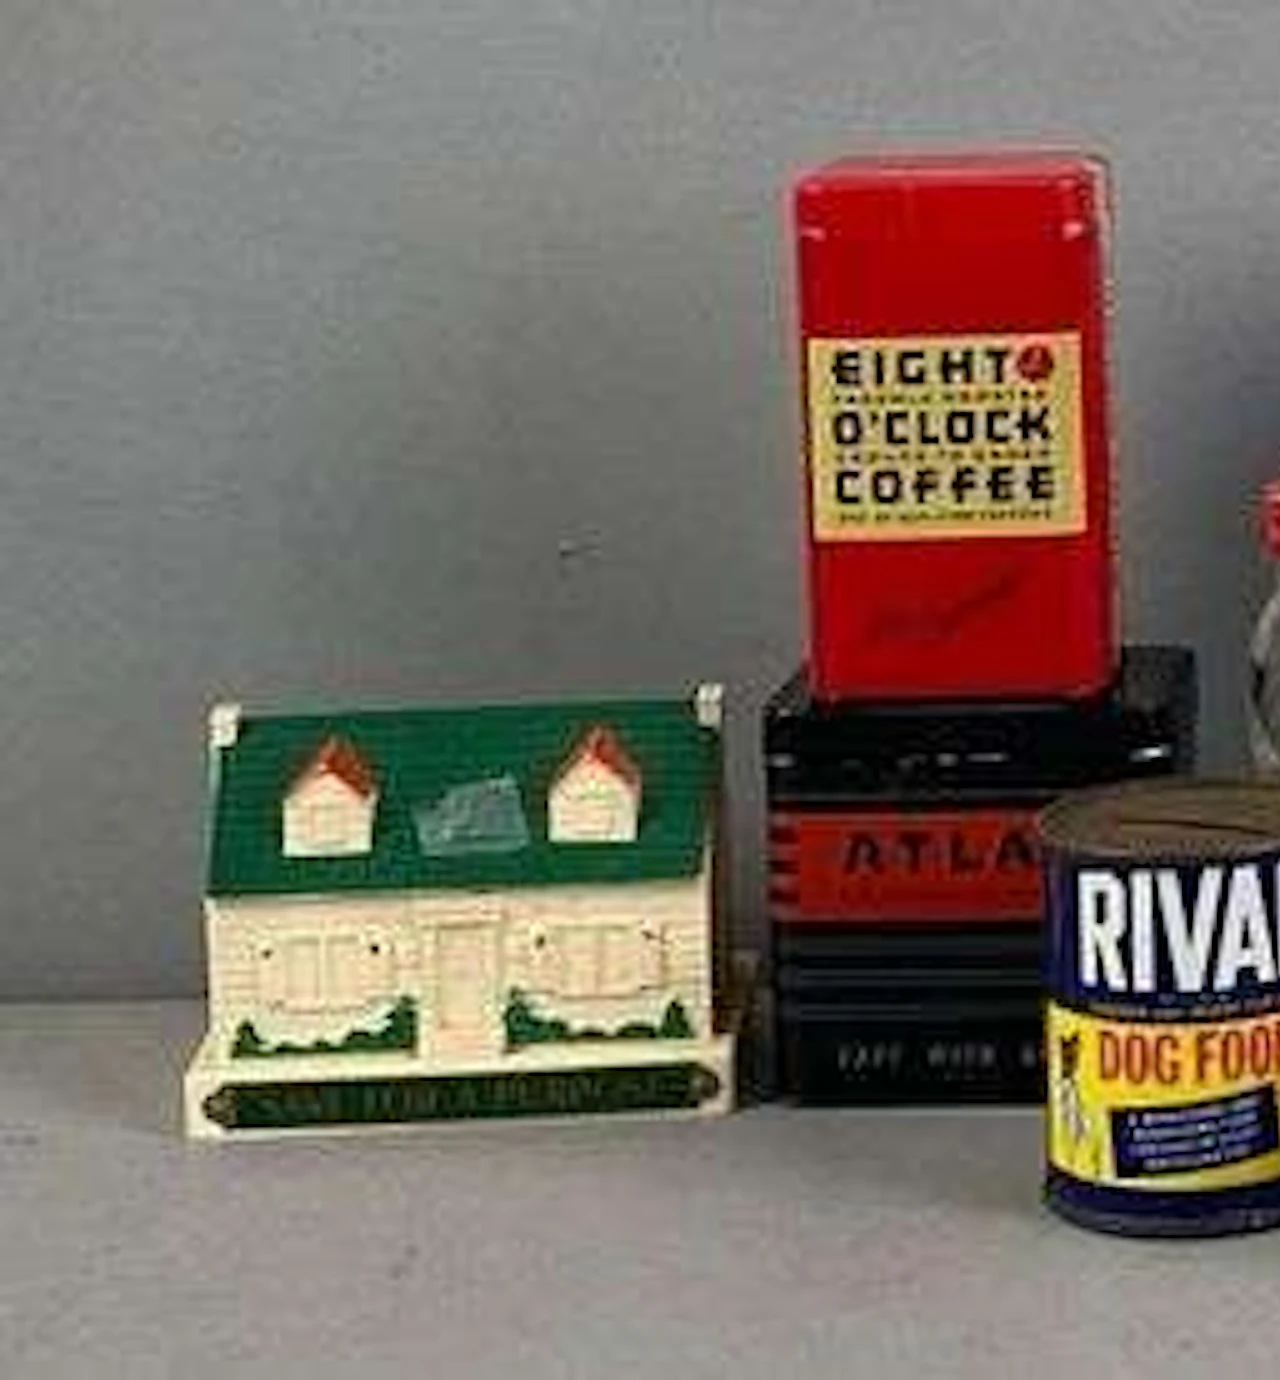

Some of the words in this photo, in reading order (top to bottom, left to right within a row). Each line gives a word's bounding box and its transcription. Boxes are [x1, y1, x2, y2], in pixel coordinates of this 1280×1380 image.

[831, 347, 1012, 385] EIGHT
[832, 407, 1049, 445] O'CLOCK
[835, 466, 1054, 503] COFFEE
[844, 831, 1035, 875] ATLA
[1098, 1029, 1181, 1084] DOG
